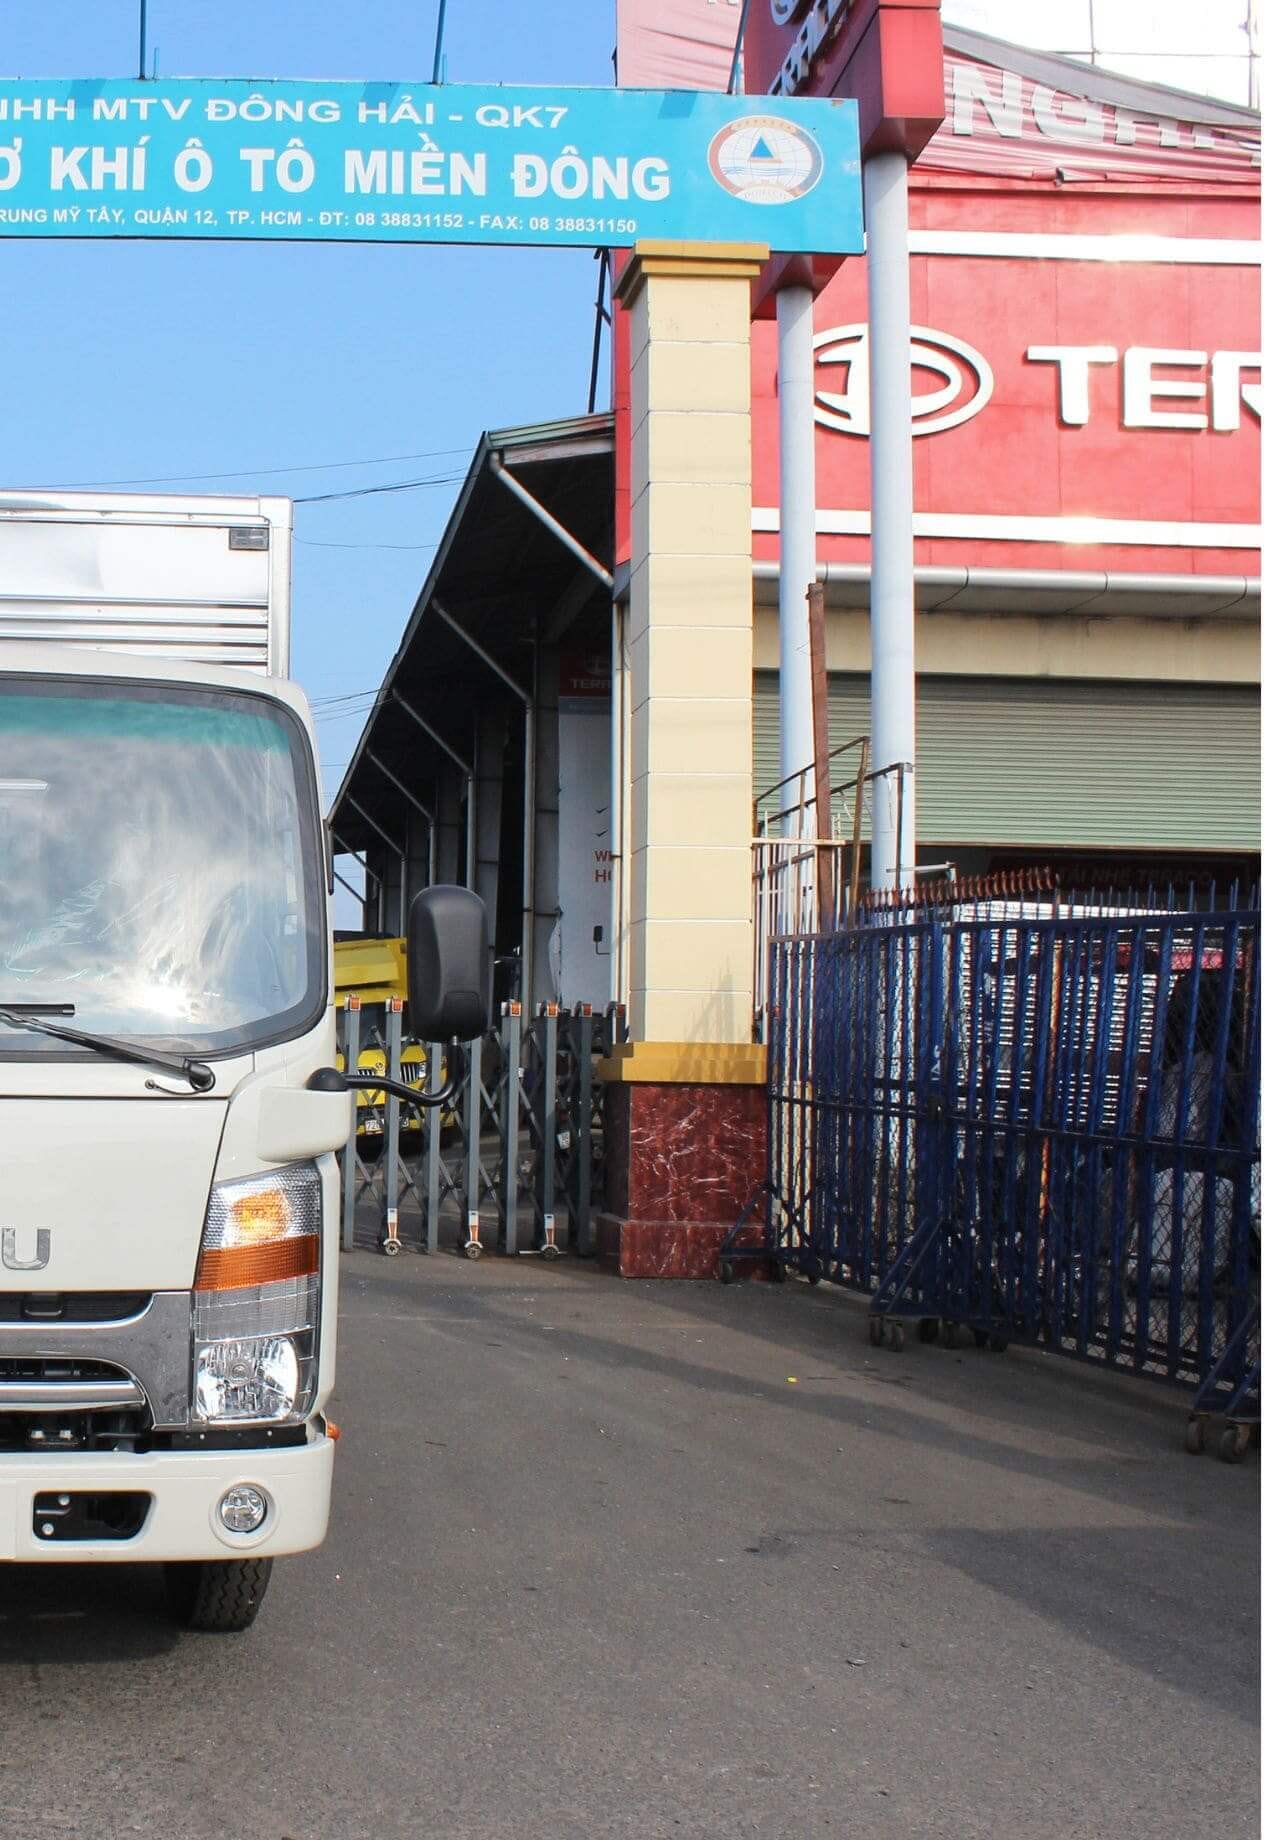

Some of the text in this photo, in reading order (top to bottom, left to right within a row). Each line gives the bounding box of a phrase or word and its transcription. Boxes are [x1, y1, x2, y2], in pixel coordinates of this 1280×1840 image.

[92, 98, 192, 121] MTV
[204, 94, 342, 123] ĐÔNG
[358, 95, 434, 125] HẢI
[475, 104, 569, 129] QK7
[49, 135, 151, 191] KHÍ
[173, 137, 213, 193] Ô
[239, 137, 315, 193] TÔ
[344, 132, 486, 197] MIỀN
[510, 145, 671, 202] ĐÔNG
[53, 205, 80, 224] MỸ
[87, 205, 125, 225] TÂY,
[134, 206, 188, 227] QUẬN
[193, 210, 218, 226] 12,
[226, 210, 254, 225] TP.
[261, 210, 301, 225] HCM
[319, 211, 349, 226] ĐT:
[354, 212, 375, 226] 08
[380, 212, 463, 228] 38831152
[479, 215, 523, 230] FAX:
[529, 216, 549, 231] 08
[554, 217, 636, 234] 38831150
